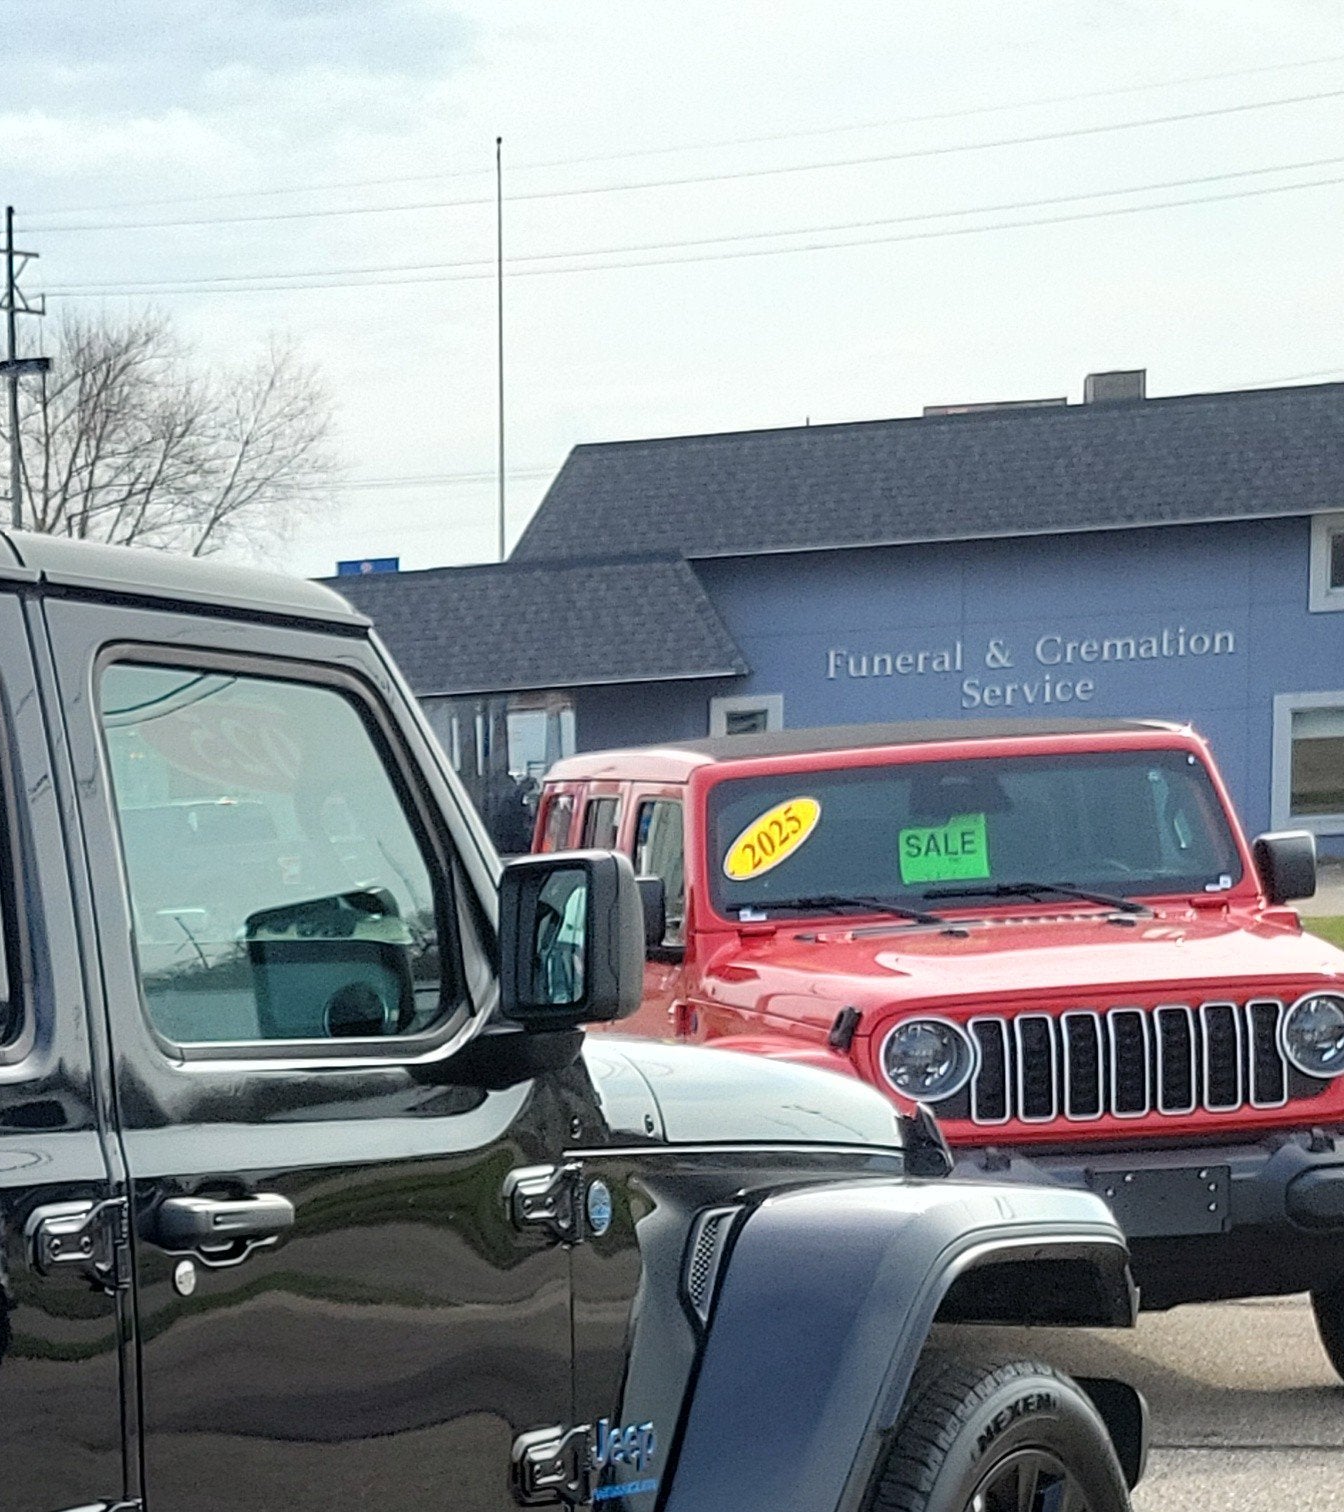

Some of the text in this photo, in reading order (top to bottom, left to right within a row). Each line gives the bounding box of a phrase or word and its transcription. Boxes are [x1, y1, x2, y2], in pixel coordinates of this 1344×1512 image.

[825, 626, 1236, 680] Funeral & Cremation
[961, 674, 1095, 710] Service
[742, 807, 802, 870] 2025
[905, 831, 975, 858] SALE
[591, 1418, 656, 1471] Jeep
[978, 1392, 1052, 1453] NEXEN
